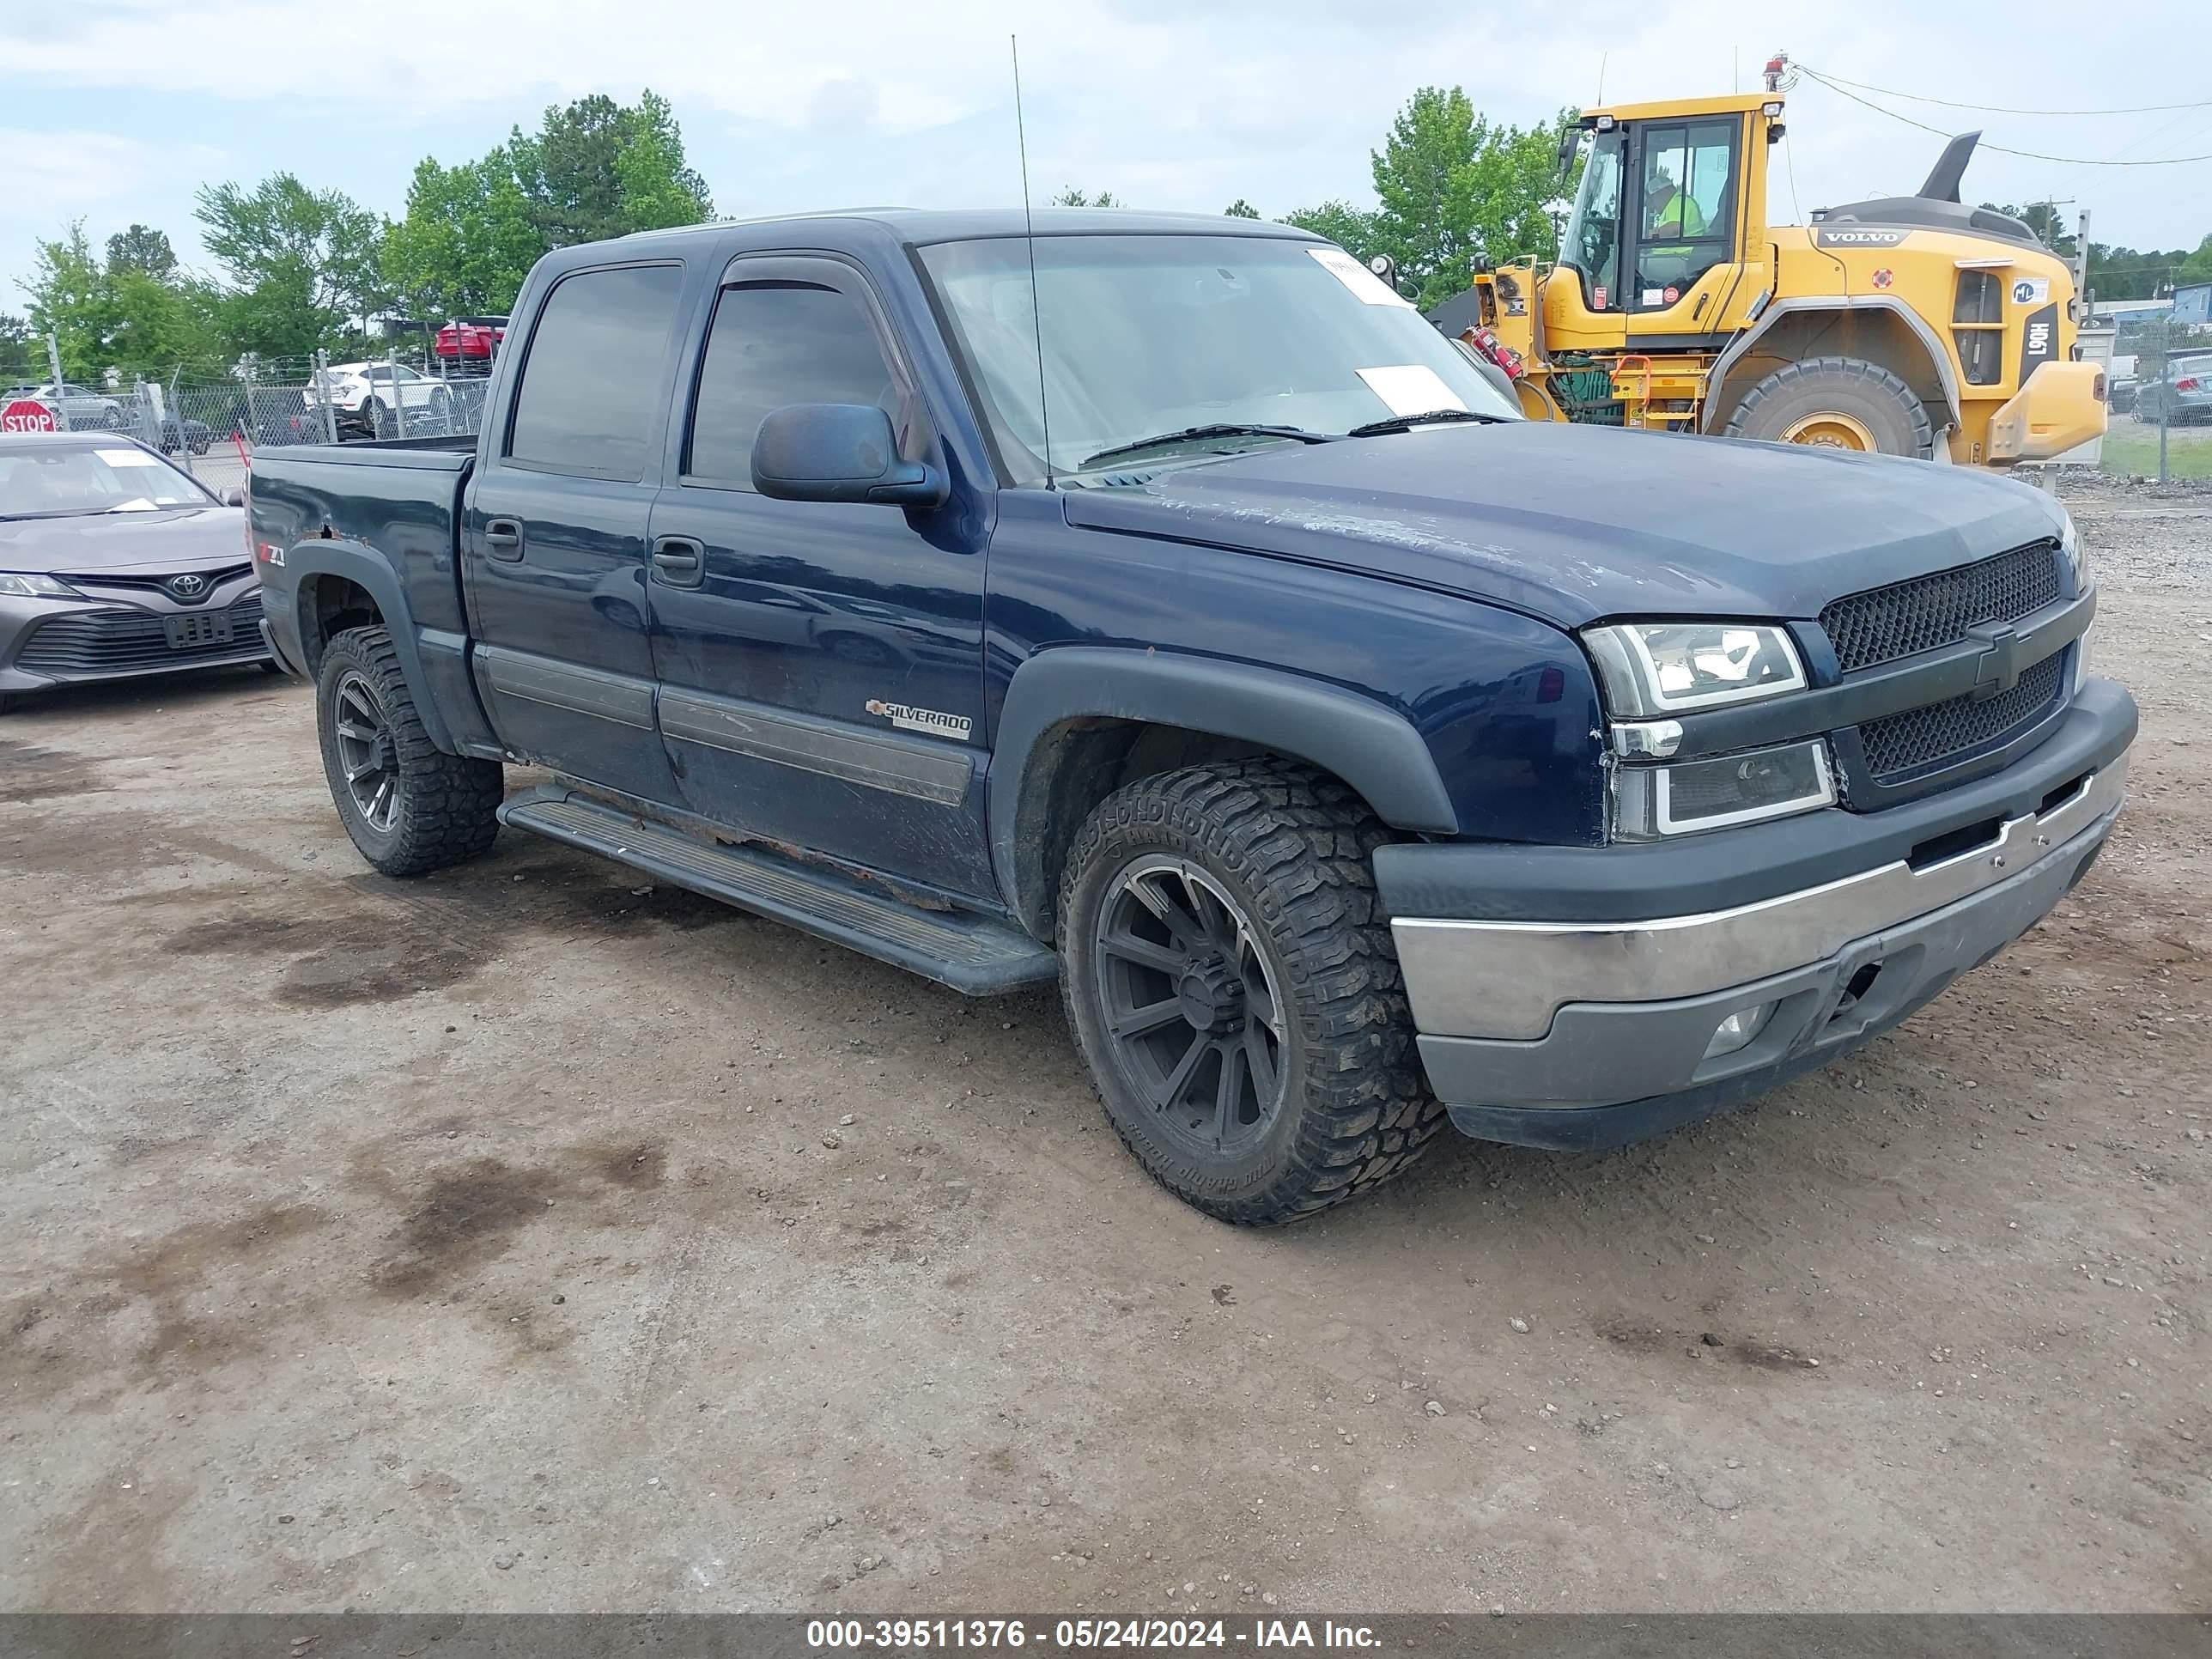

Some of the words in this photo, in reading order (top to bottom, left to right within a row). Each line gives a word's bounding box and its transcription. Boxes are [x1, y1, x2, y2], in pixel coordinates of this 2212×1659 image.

[1825, 233, 1898, 241] VOLVO
[2027, 323, 2050, 355] L90H
[5, 414, 51, 432] STOP
[885, 704, 971, 731] SILVERADO
